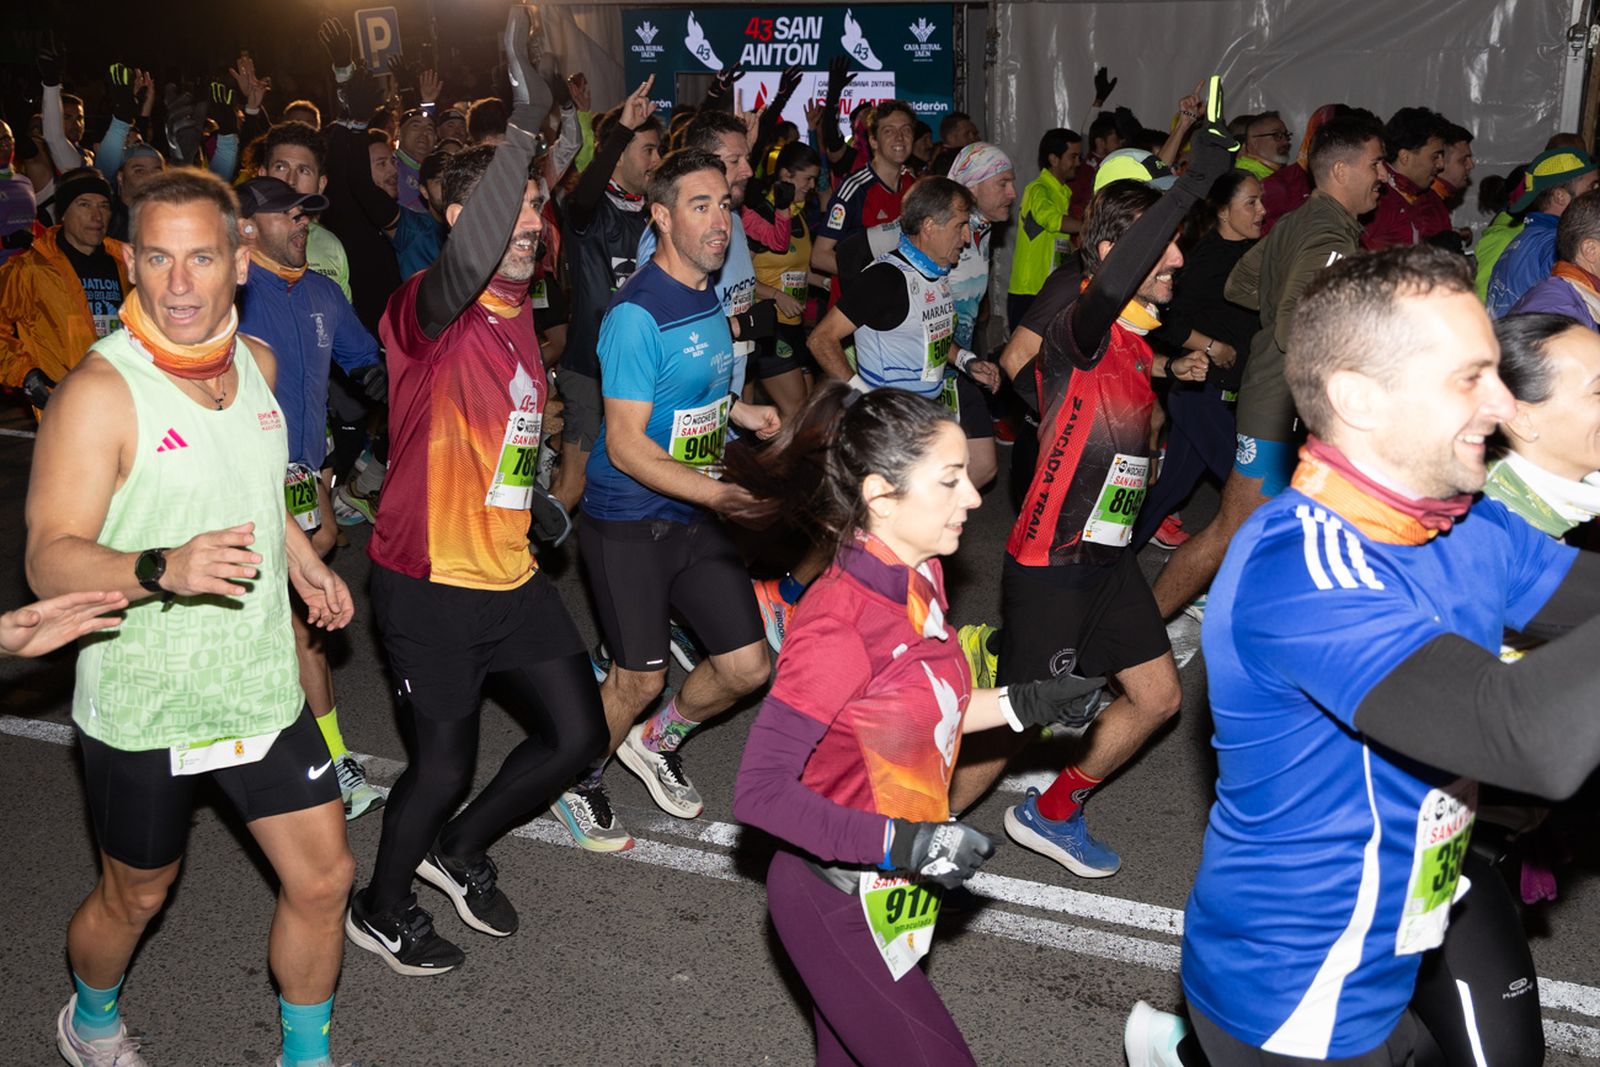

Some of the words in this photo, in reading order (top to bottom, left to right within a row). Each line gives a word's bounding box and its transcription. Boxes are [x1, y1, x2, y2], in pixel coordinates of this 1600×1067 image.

[744, 16, 773, 42] 43
[774, 16, 823, 39] SAN
[366, 17, 391, 68] P
[696, 44, 711, 61] 43
[739, 37, 819, 66] ANTÓN
[853, 43, 869, 60] 43
[903, 43, 919, 51] CAJA
[920, 43, 942, 51] RURAL
[843, 89, 853, 97] DE
[512, 435, 526, 444] SAN
[681, 427, 697, 437] SAN
[1042, 396, 1082, 484] ZANCADA
[1114, 475, 1128, 486] SAN
[1025, 491, 1050, 541] TRAIL
[567, 800, 593, 834] HOKA
[1430, 820, 1453, 844] SAN
